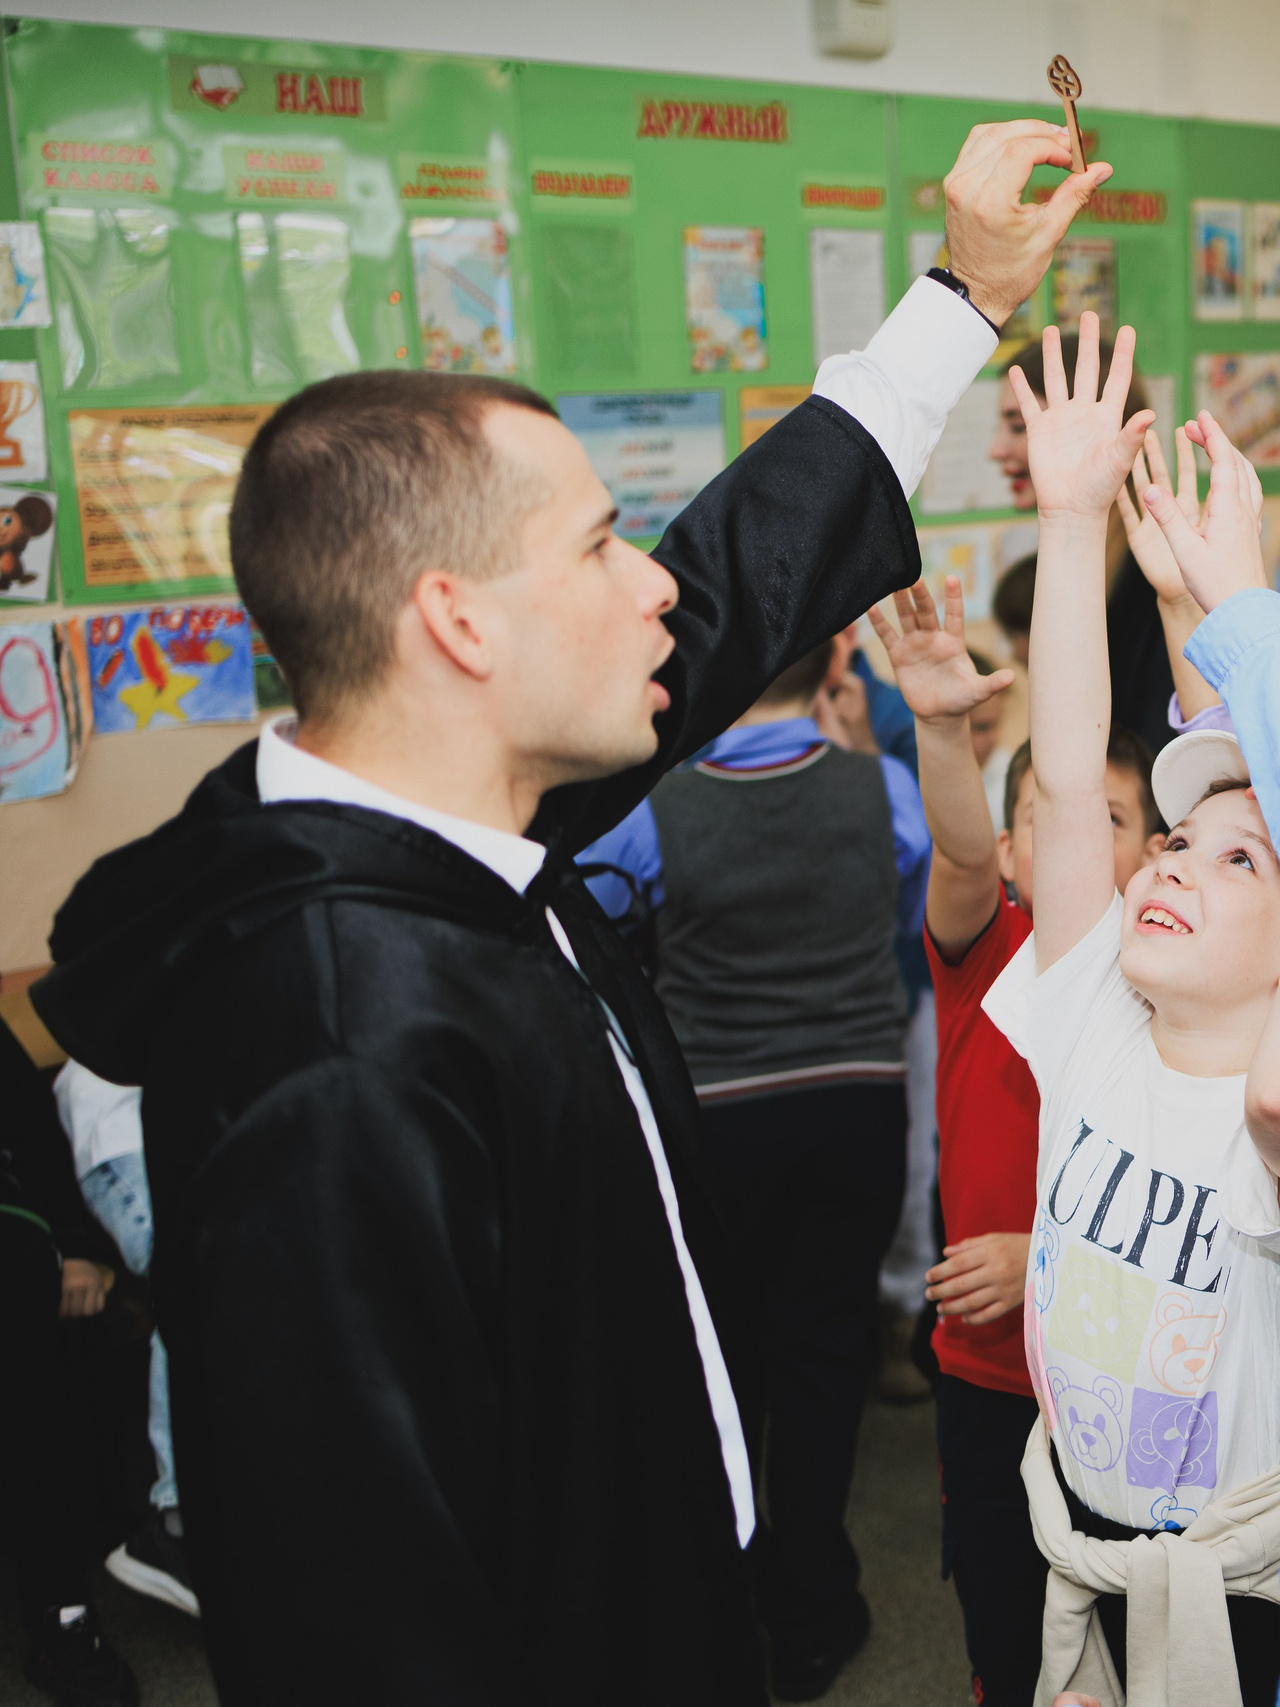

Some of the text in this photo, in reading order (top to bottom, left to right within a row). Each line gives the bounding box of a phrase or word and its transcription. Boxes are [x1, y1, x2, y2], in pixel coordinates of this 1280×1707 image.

[276, 73, 363, 116] НАШ
[638, 100, 787, 143] ДРУЖНЫЙ
[41, 141, 155, 166] СПИСОК
[44, 169, 159, 194] КЛАССА
[1049, 1115, 1232, 1294] ULPE
